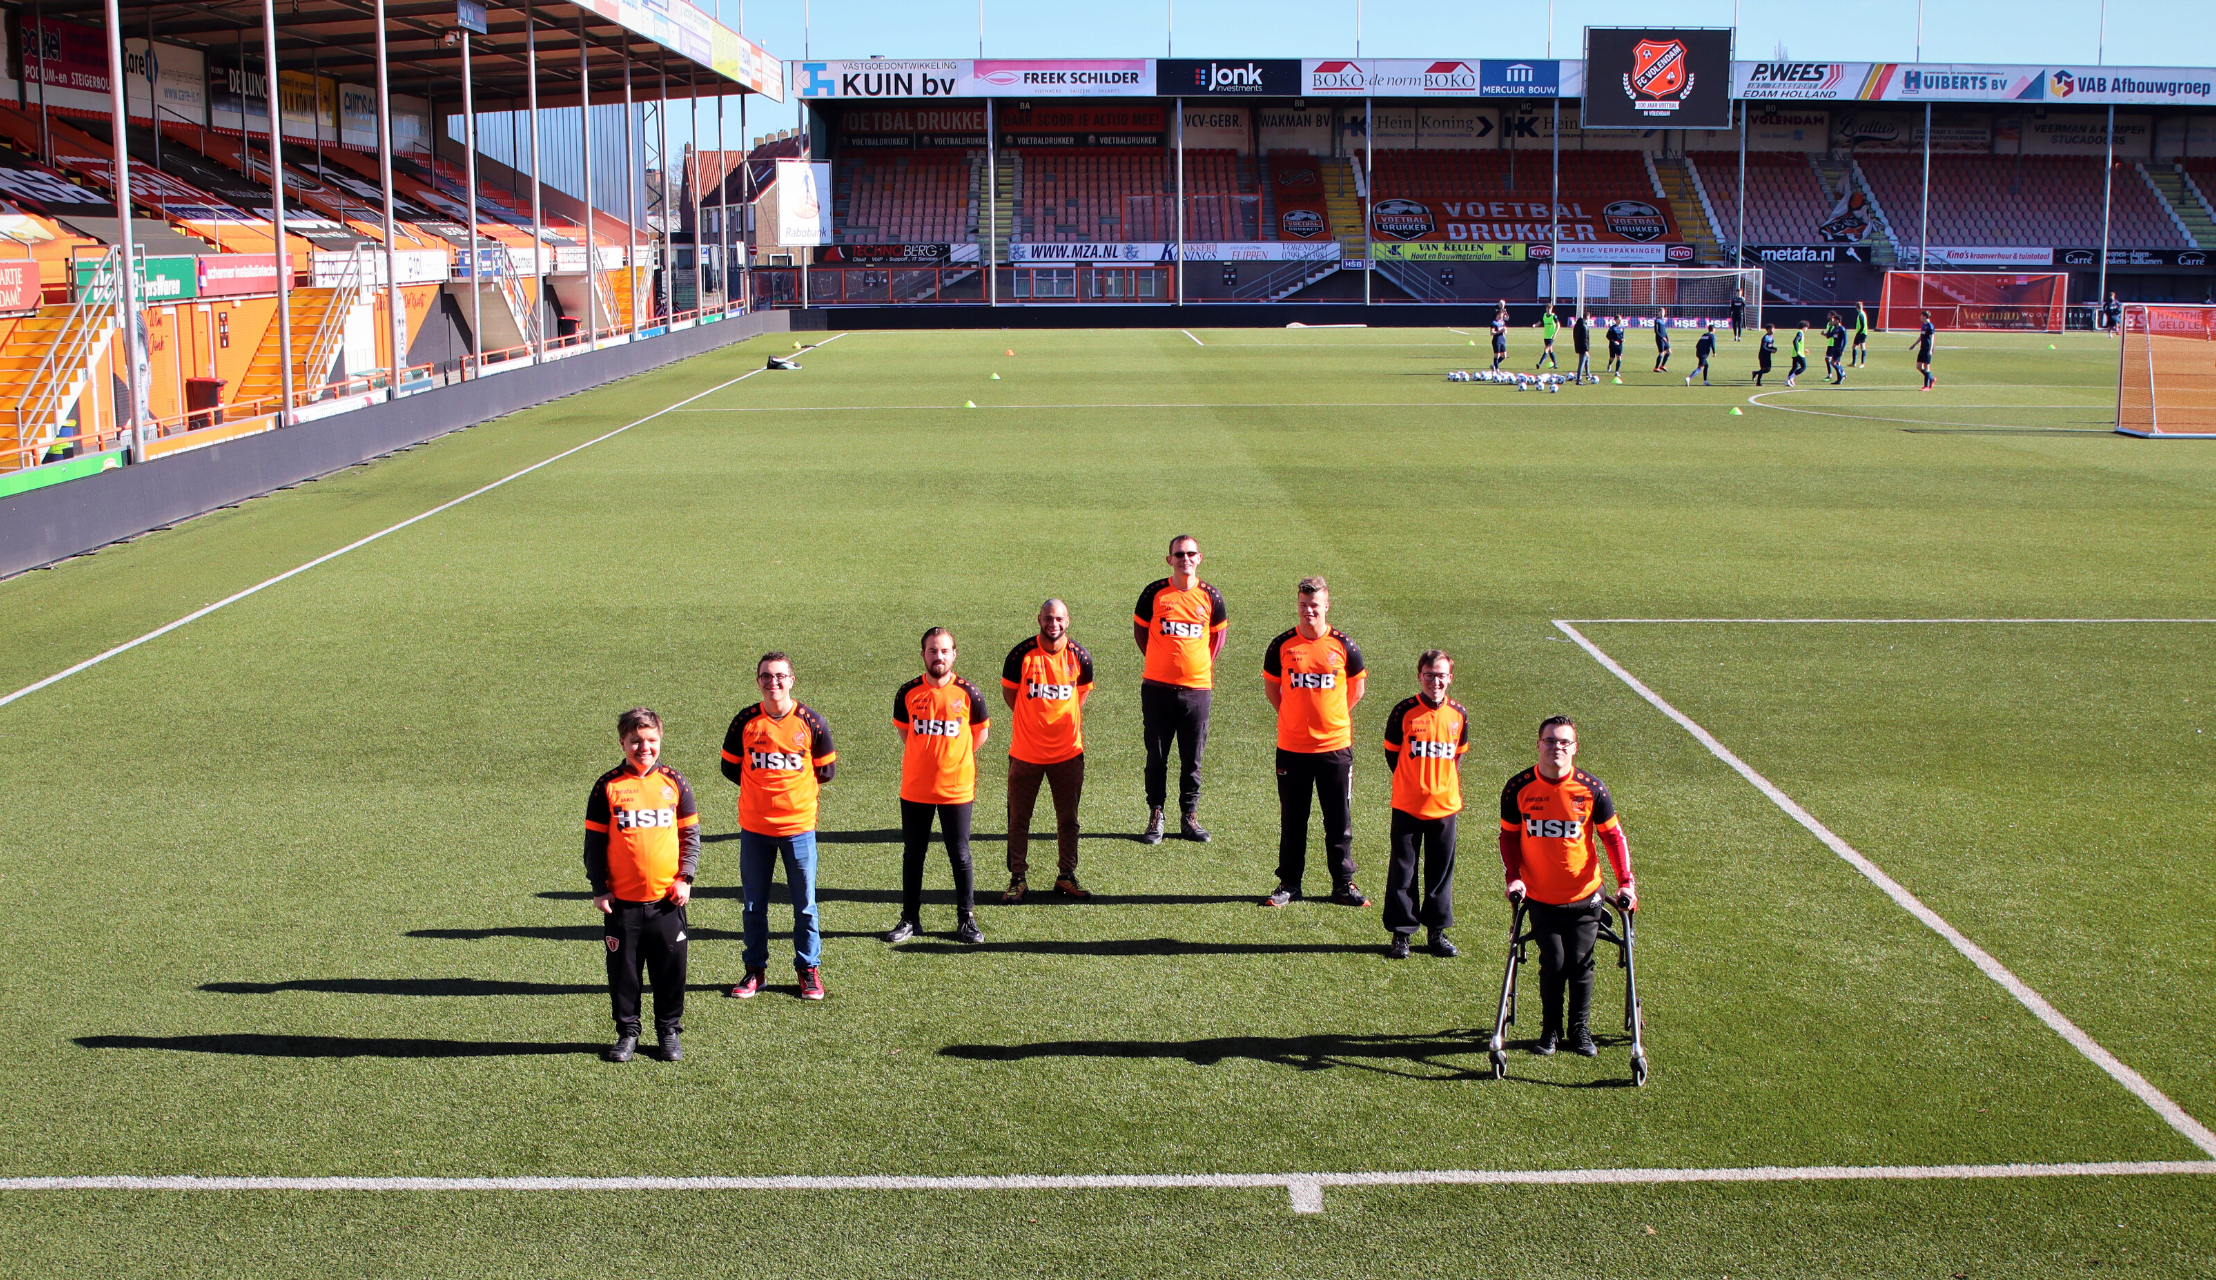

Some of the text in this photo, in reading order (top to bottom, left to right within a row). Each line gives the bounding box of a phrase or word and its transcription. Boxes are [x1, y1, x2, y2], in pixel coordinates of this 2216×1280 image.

[842, 62, 957, 70] VASTGOEDONTWIKKELING
[1636, 45, 1682, 88] FC VOLENDAM
[25, 65, 110, 92] PODUM-en STEIGERBOU
[1023, 72, 1140, 84] FREEK SCHILDER
[1209, 63, 1263, 91] jonk
[1369, 73, 1384, 86] de
[1386, 76, 1422, 86] norm
[1424, 74, 1475, 87] BOKO
[1904, 70, 2008, 91] HUIBERTS BV
[243, 71, 268, 99] LUNC
[843, 73, 955, 96] KUIN bv
[1216, 84, 1263, 92] investments
[1482, 85, 1556, 94] MERCUUR BOUW
[2077, 77, 2211, 97] VAB Afbouwgroep
[1743, 90, 1837, 98] EDAM HOLLAND
[1019, 102, 1031, 110] BA
[1003, 112, 1160, 127] DAAR SCOOR JE ALTIJD MEE!
[1260, 114, 1331, 128] WAKMAN BV
[1377, 115, 1412, 129] Hein
[1421, 115, 1474, 132] Koning
[1749, 114, 1825, 126] VOLENDAM
[2034, 123, 2088, 134] VEERMAN
[2100, 124, 2145, 135] KMPER
[851, 137, 909, 146] VOETBALDRUKKER
[934, 137, 987, 146] VOETBALDRUKKE
[1017, 137, 1075, 145] VOETBALDRUKKER
[1100, 136, 1157, 145] VOETBALDRUKKER
[1442, 202, 1592, 219] VOETBAL
[1380, 215, 1425, 224] VOETBAL
[1612, 217, 1658, 225] VOETBAL
[785, 226, 827, 238] Rabobank
[1381, 223, 1428, 231] DRUKKER
[1447, 223, 1598, 241] DRUKKER
[1615, 225, 1661, 234] DRUKKER
[852, 244, 938, 257] TECHNOBERG
[1031, 244, 1119, 259] WWW.MZA.NL
[1419, 243, 1484, 252] VAN KEULEN
[1669, 249, 1691, 257] KIVO
[1231, 250, 1269, 260] FLIPPEN
[1411, 252, 1427, 260] Hout
[1437, 252, 1492, 261] Bouwmaterialen
[1761, 246, 1836, 262] metafa.nl
[1946, 250, 1969, 259] Kino's
[1970, 252, 2012, 260] kraanverhuur
[2019, 252, 2050, 260] tuintotaal
[2065, 254, 2093, 265] Carré
[1345, 260, 1363, 268] HSB
[2177, 255, 2206, 266] Carré
[207, 263, 278, 280] schermer installatietechn
[1963, 307, 2020, 321] Veerman
[1570, 317, 1595, 327] HB
[1639, 317, 1656, 327] HS
[1674, 318, 1697, 328] HSB
[1706, 318, 1729, 328] HSB
[1161, 621, 1203, 638] HSB
[1290, 672, 1336, 689] HSB
[1029, 682, 1073, 700] HSB
[913, 719, 960, 737] HSB
[1410, 741, 1456, 759] HSB
[751, 752, 803, 771] HSB
[617, 808, 674, 828] HSB
[1525, 819, 1582, 838] HSB
